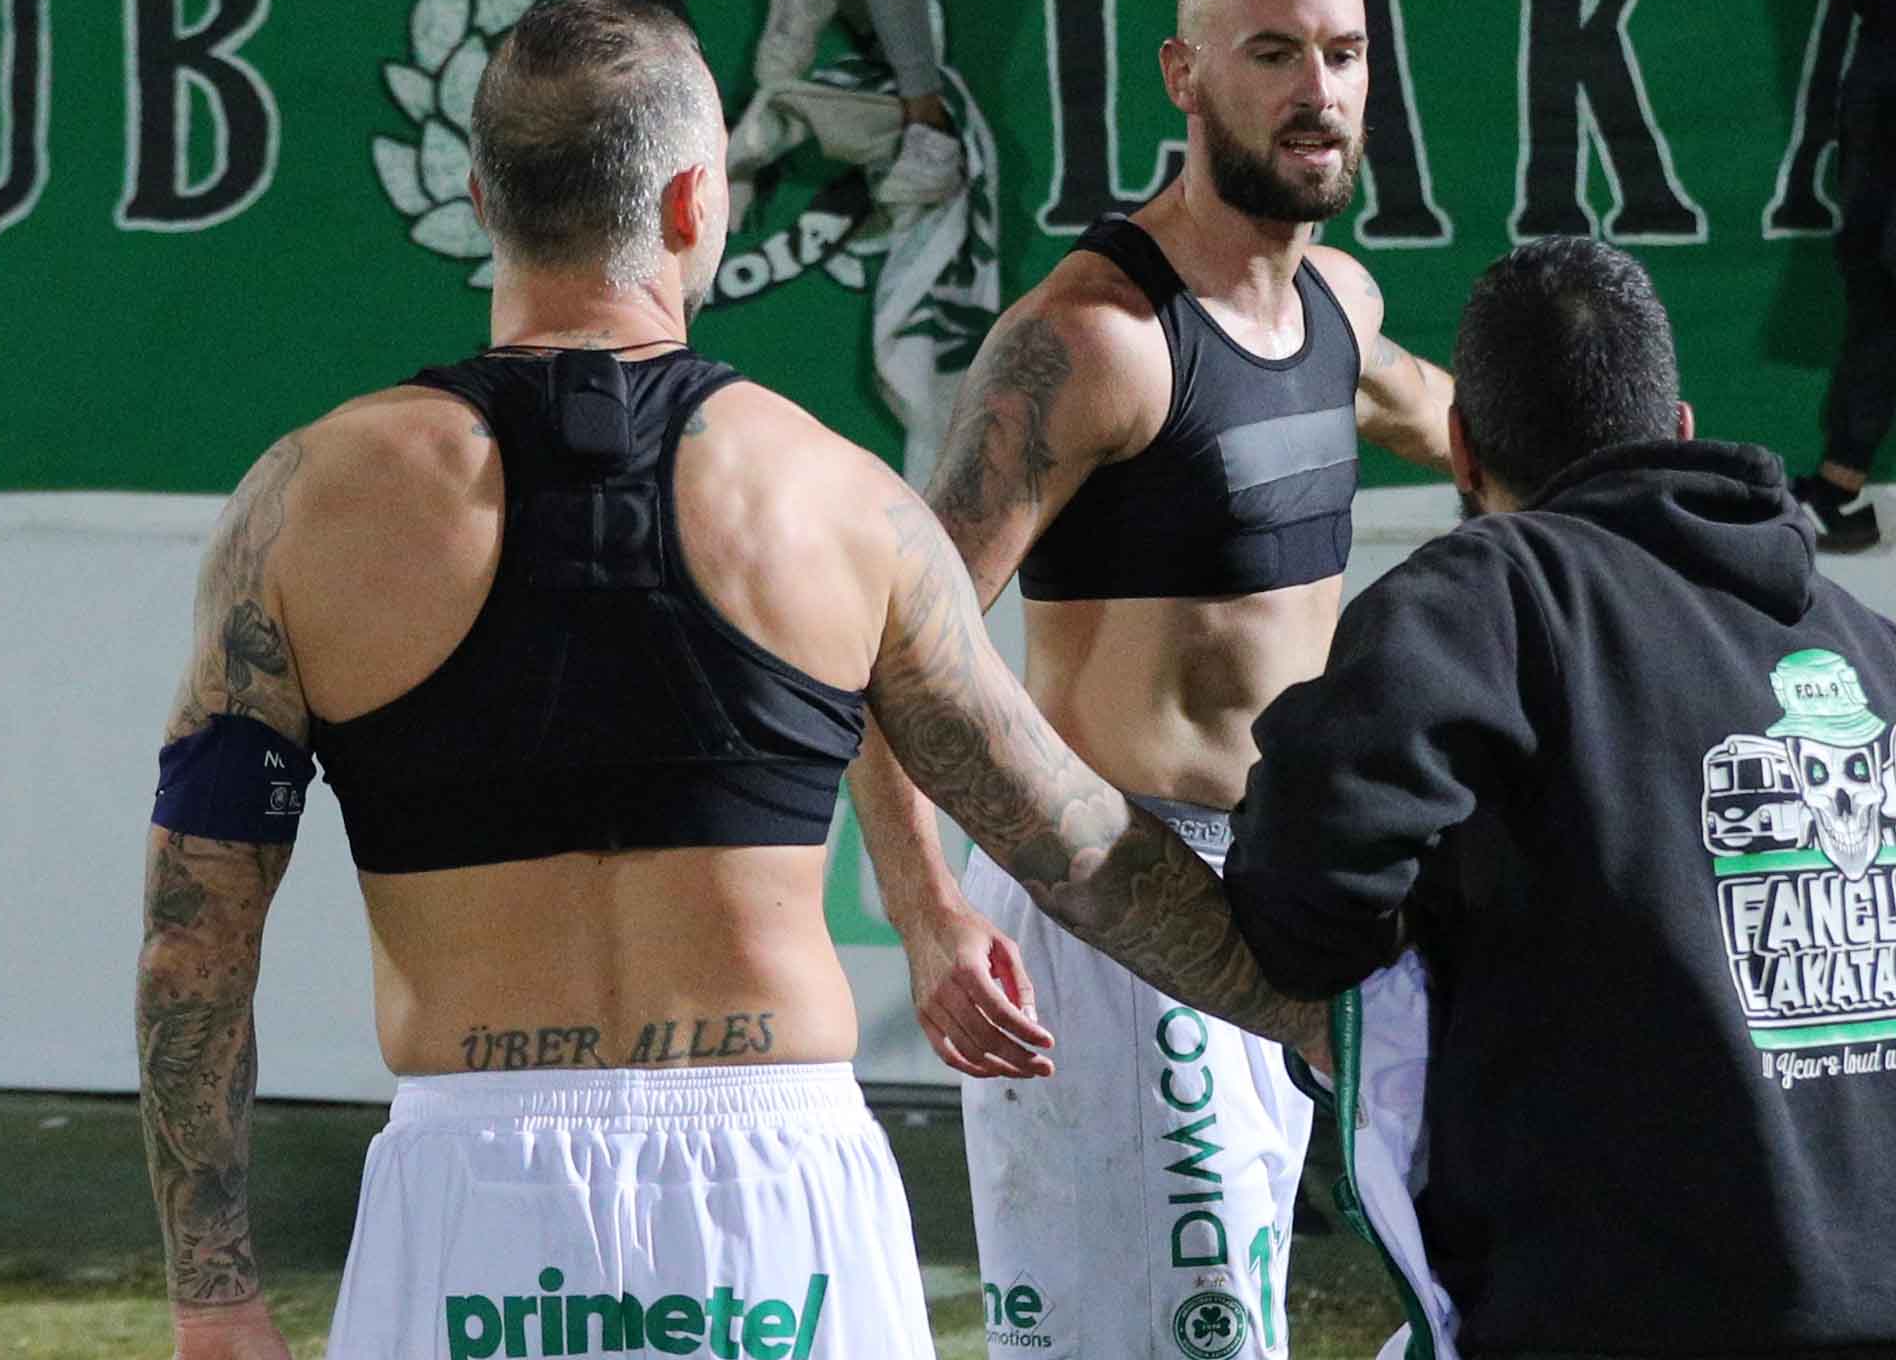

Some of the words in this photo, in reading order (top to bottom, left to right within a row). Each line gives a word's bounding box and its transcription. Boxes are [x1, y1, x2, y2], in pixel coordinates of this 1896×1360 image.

[461, 1025, 606, 1071] ÜBER
[629, 1012, 776, 1065] ALLES
[1776, 1051, 1842, 1090] Years
[1843, 1043, 1883, 1075] loud
[1156, 1006, 1228, 1268] DIMCO
